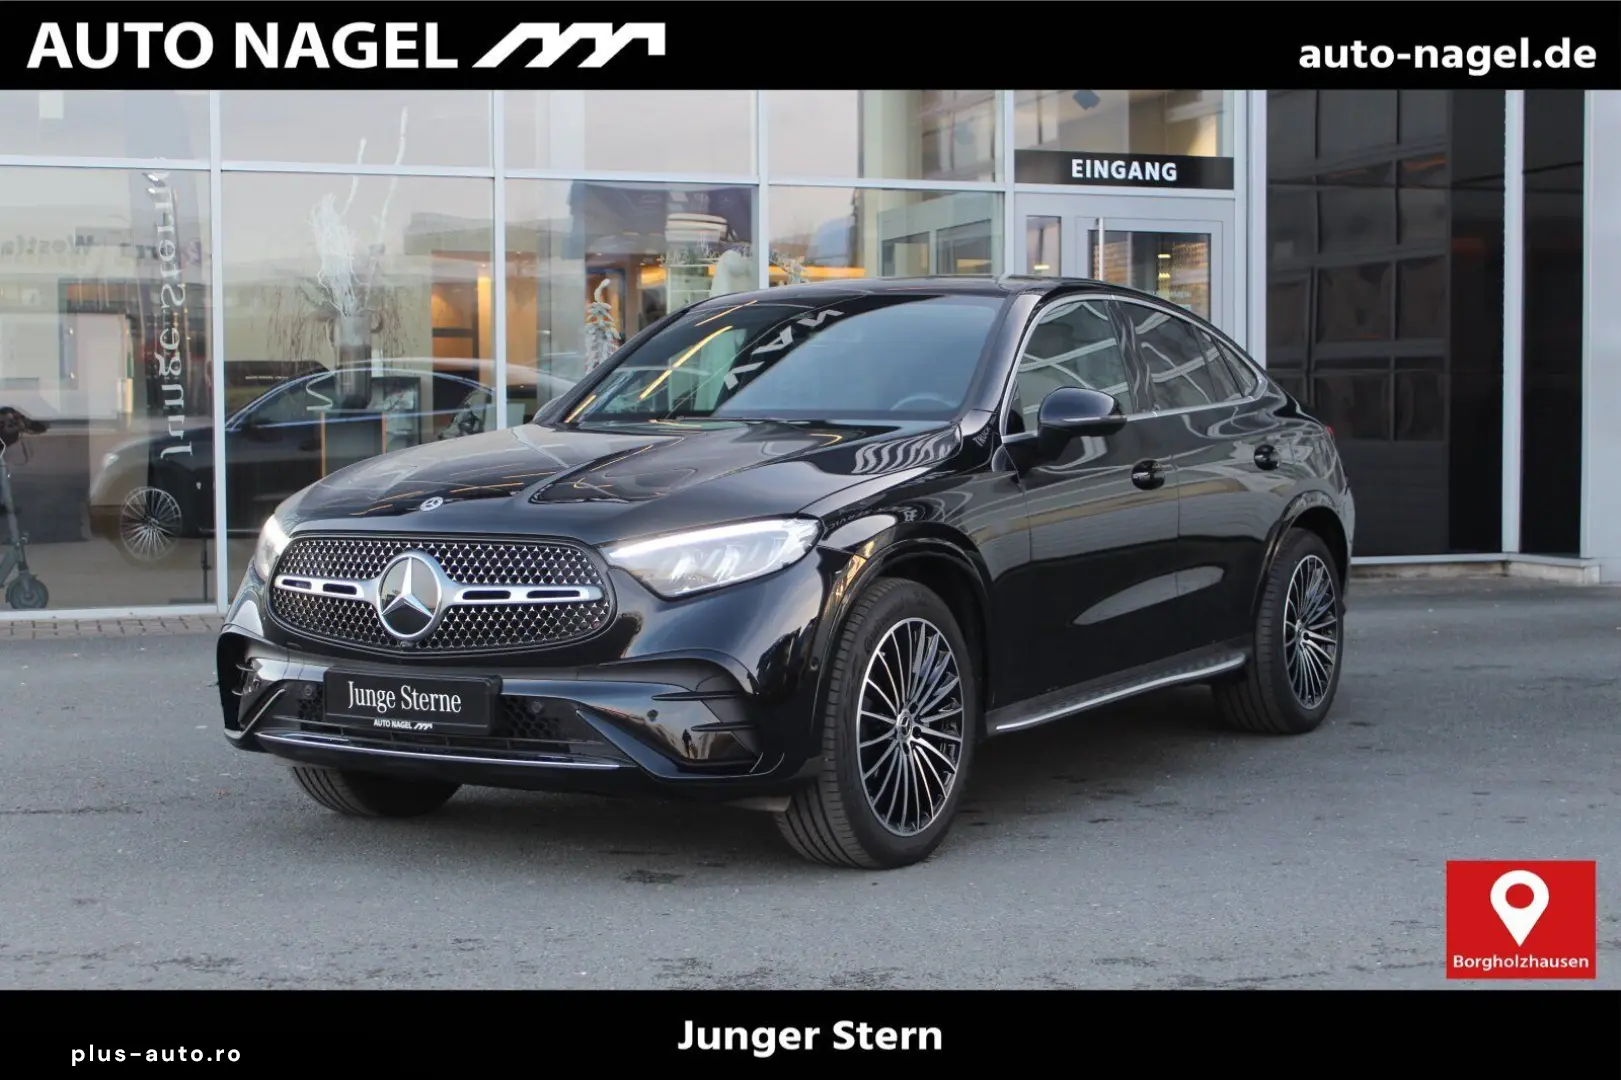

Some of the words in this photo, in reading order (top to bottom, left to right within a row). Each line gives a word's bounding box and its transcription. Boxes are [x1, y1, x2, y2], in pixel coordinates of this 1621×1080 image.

[1071, 158, 1178, 181] EINGANG
[348, 681, 396, 713] Junge
[400, 685, 462, 713] Sterne
[373, 718, 391, 728] AUTO
[391, 719, 413, 730] NAGEL
